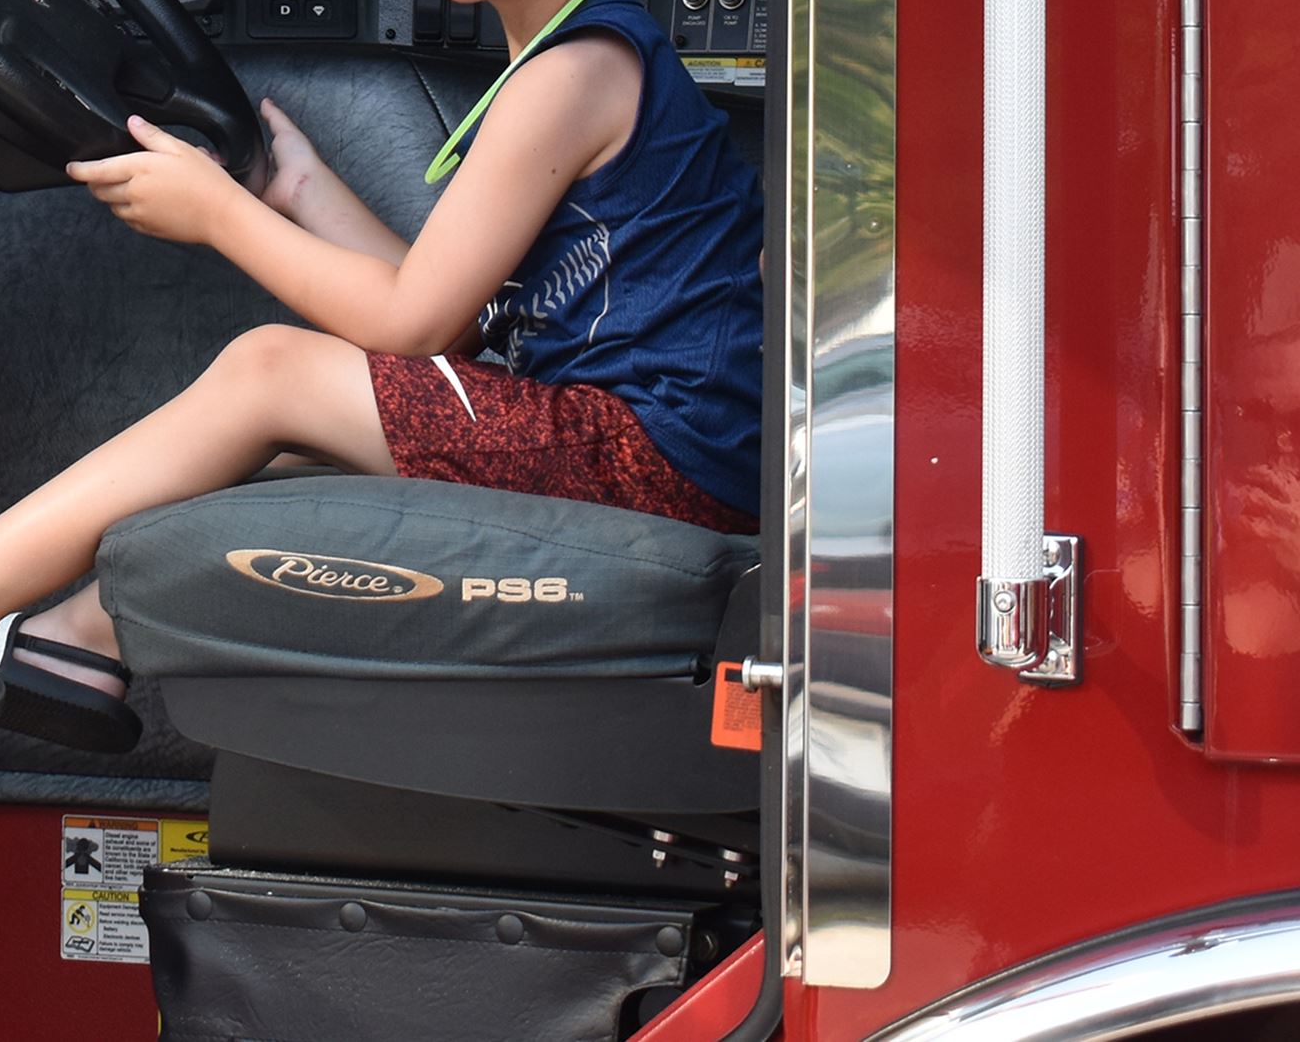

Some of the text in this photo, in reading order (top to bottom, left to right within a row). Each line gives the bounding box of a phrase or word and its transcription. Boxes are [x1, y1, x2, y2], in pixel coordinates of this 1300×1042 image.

[280, 5, 291, 15] D
[272, 555, 391, 593] Pierce
[92, 890, 130, 901] CAUTION
